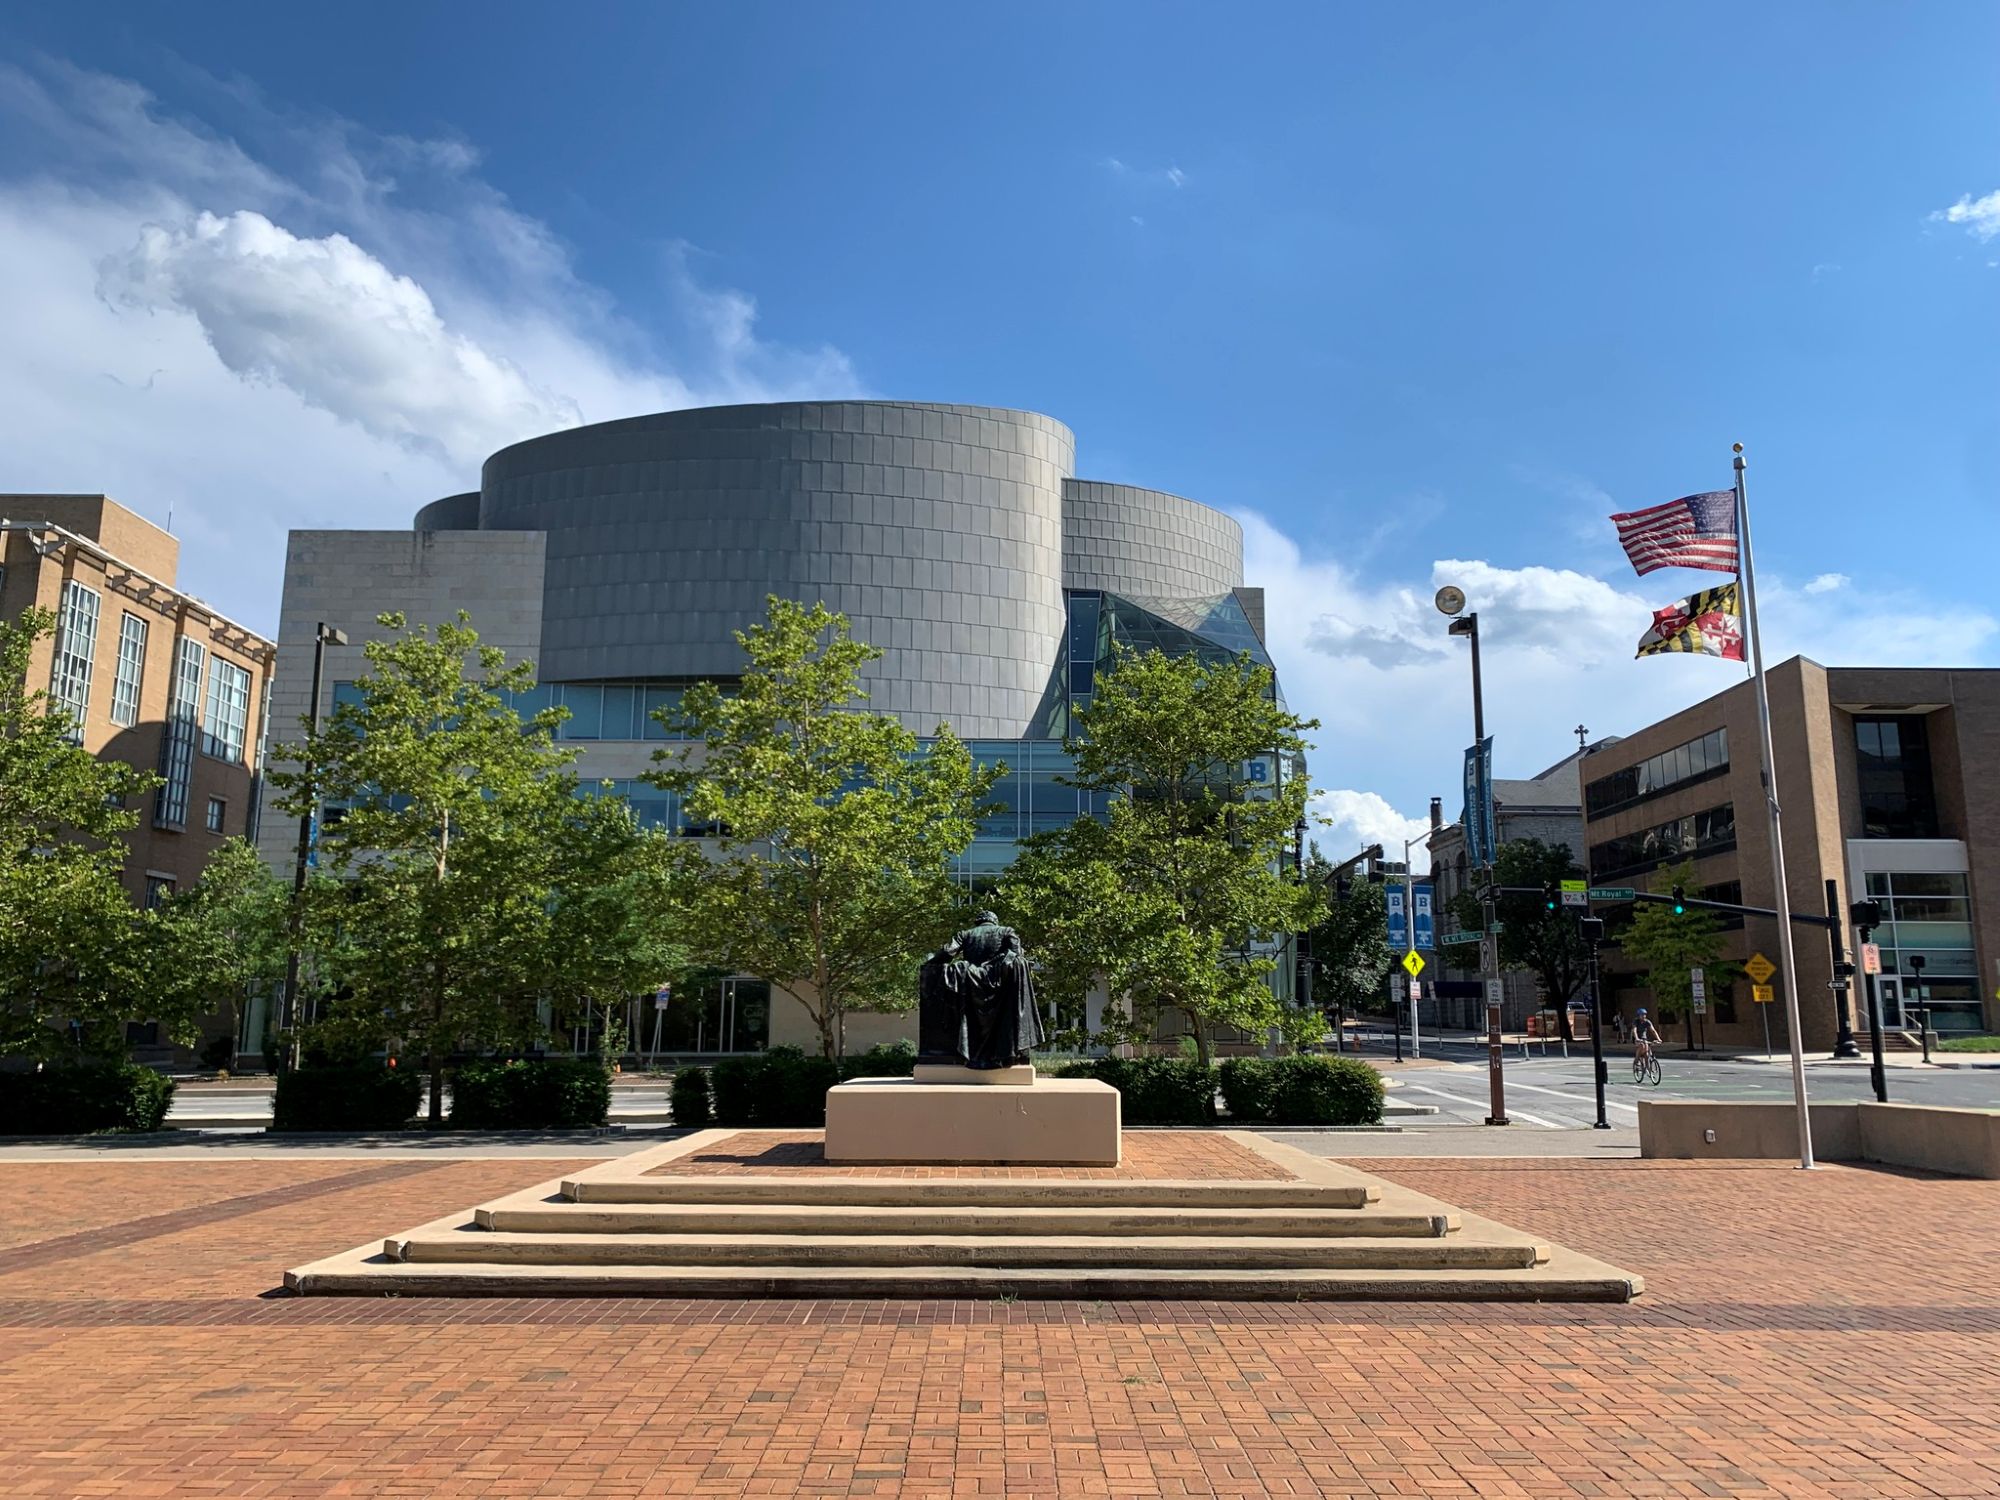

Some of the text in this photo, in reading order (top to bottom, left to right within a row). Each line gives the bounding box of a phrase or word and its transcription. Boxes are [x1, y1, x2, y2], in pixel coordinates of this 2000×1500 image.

[1248, 762, 1266, 782] B
[1601, 890, 1622, 899] Royal
[1392, 896, 1401, 907] B
[1419, 896, 1428, 907] B
